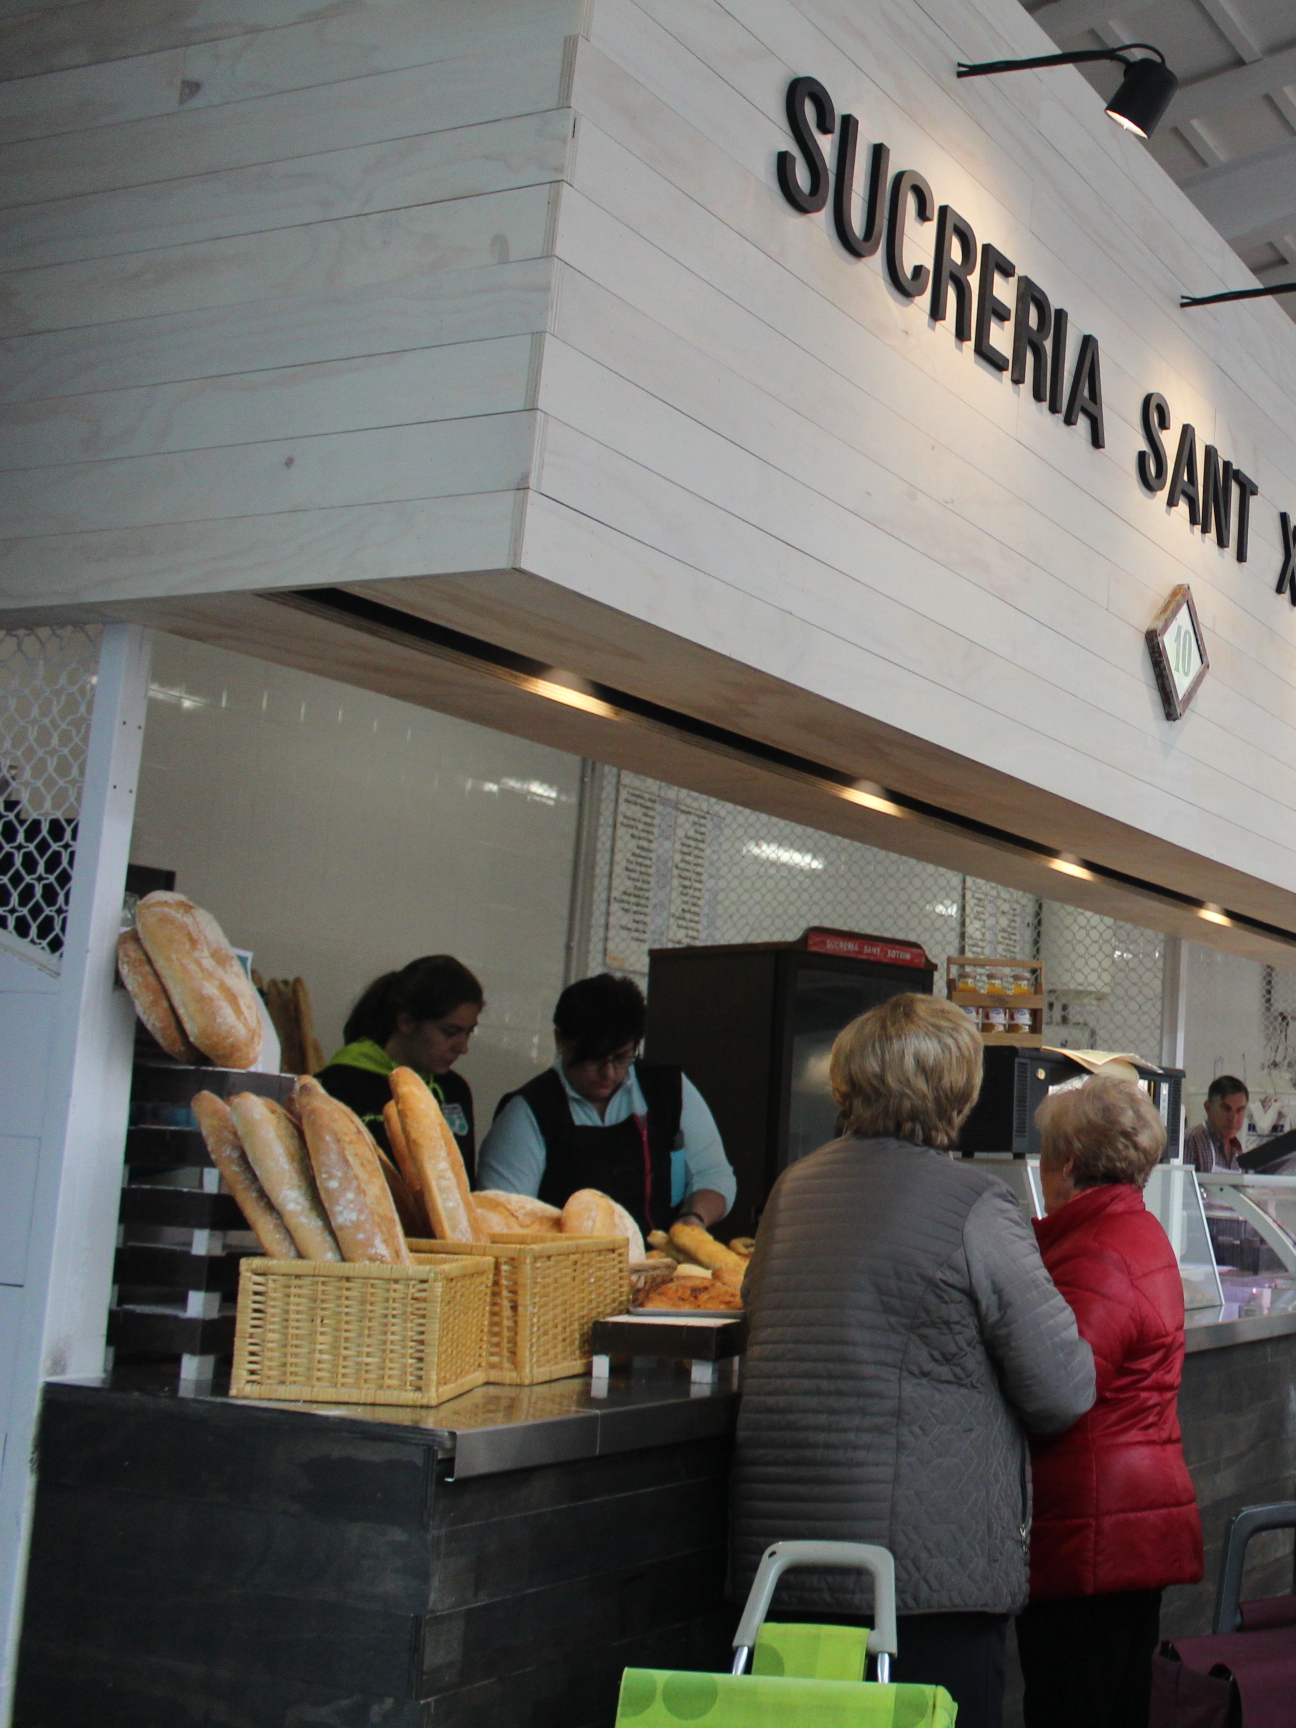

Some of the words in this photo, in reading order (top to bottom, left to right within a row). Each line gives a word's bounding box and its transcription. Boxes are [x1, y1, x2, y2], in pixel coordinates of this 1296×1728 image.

[777, 76, 1105, 449] SUCRERIA
[1138, 392, 1259, 562] SANT
[1174, 624, 1193, 677] 10
[826, 939, 859, 952] SUCRERIA
[863, 944, 882, 957] SANT
